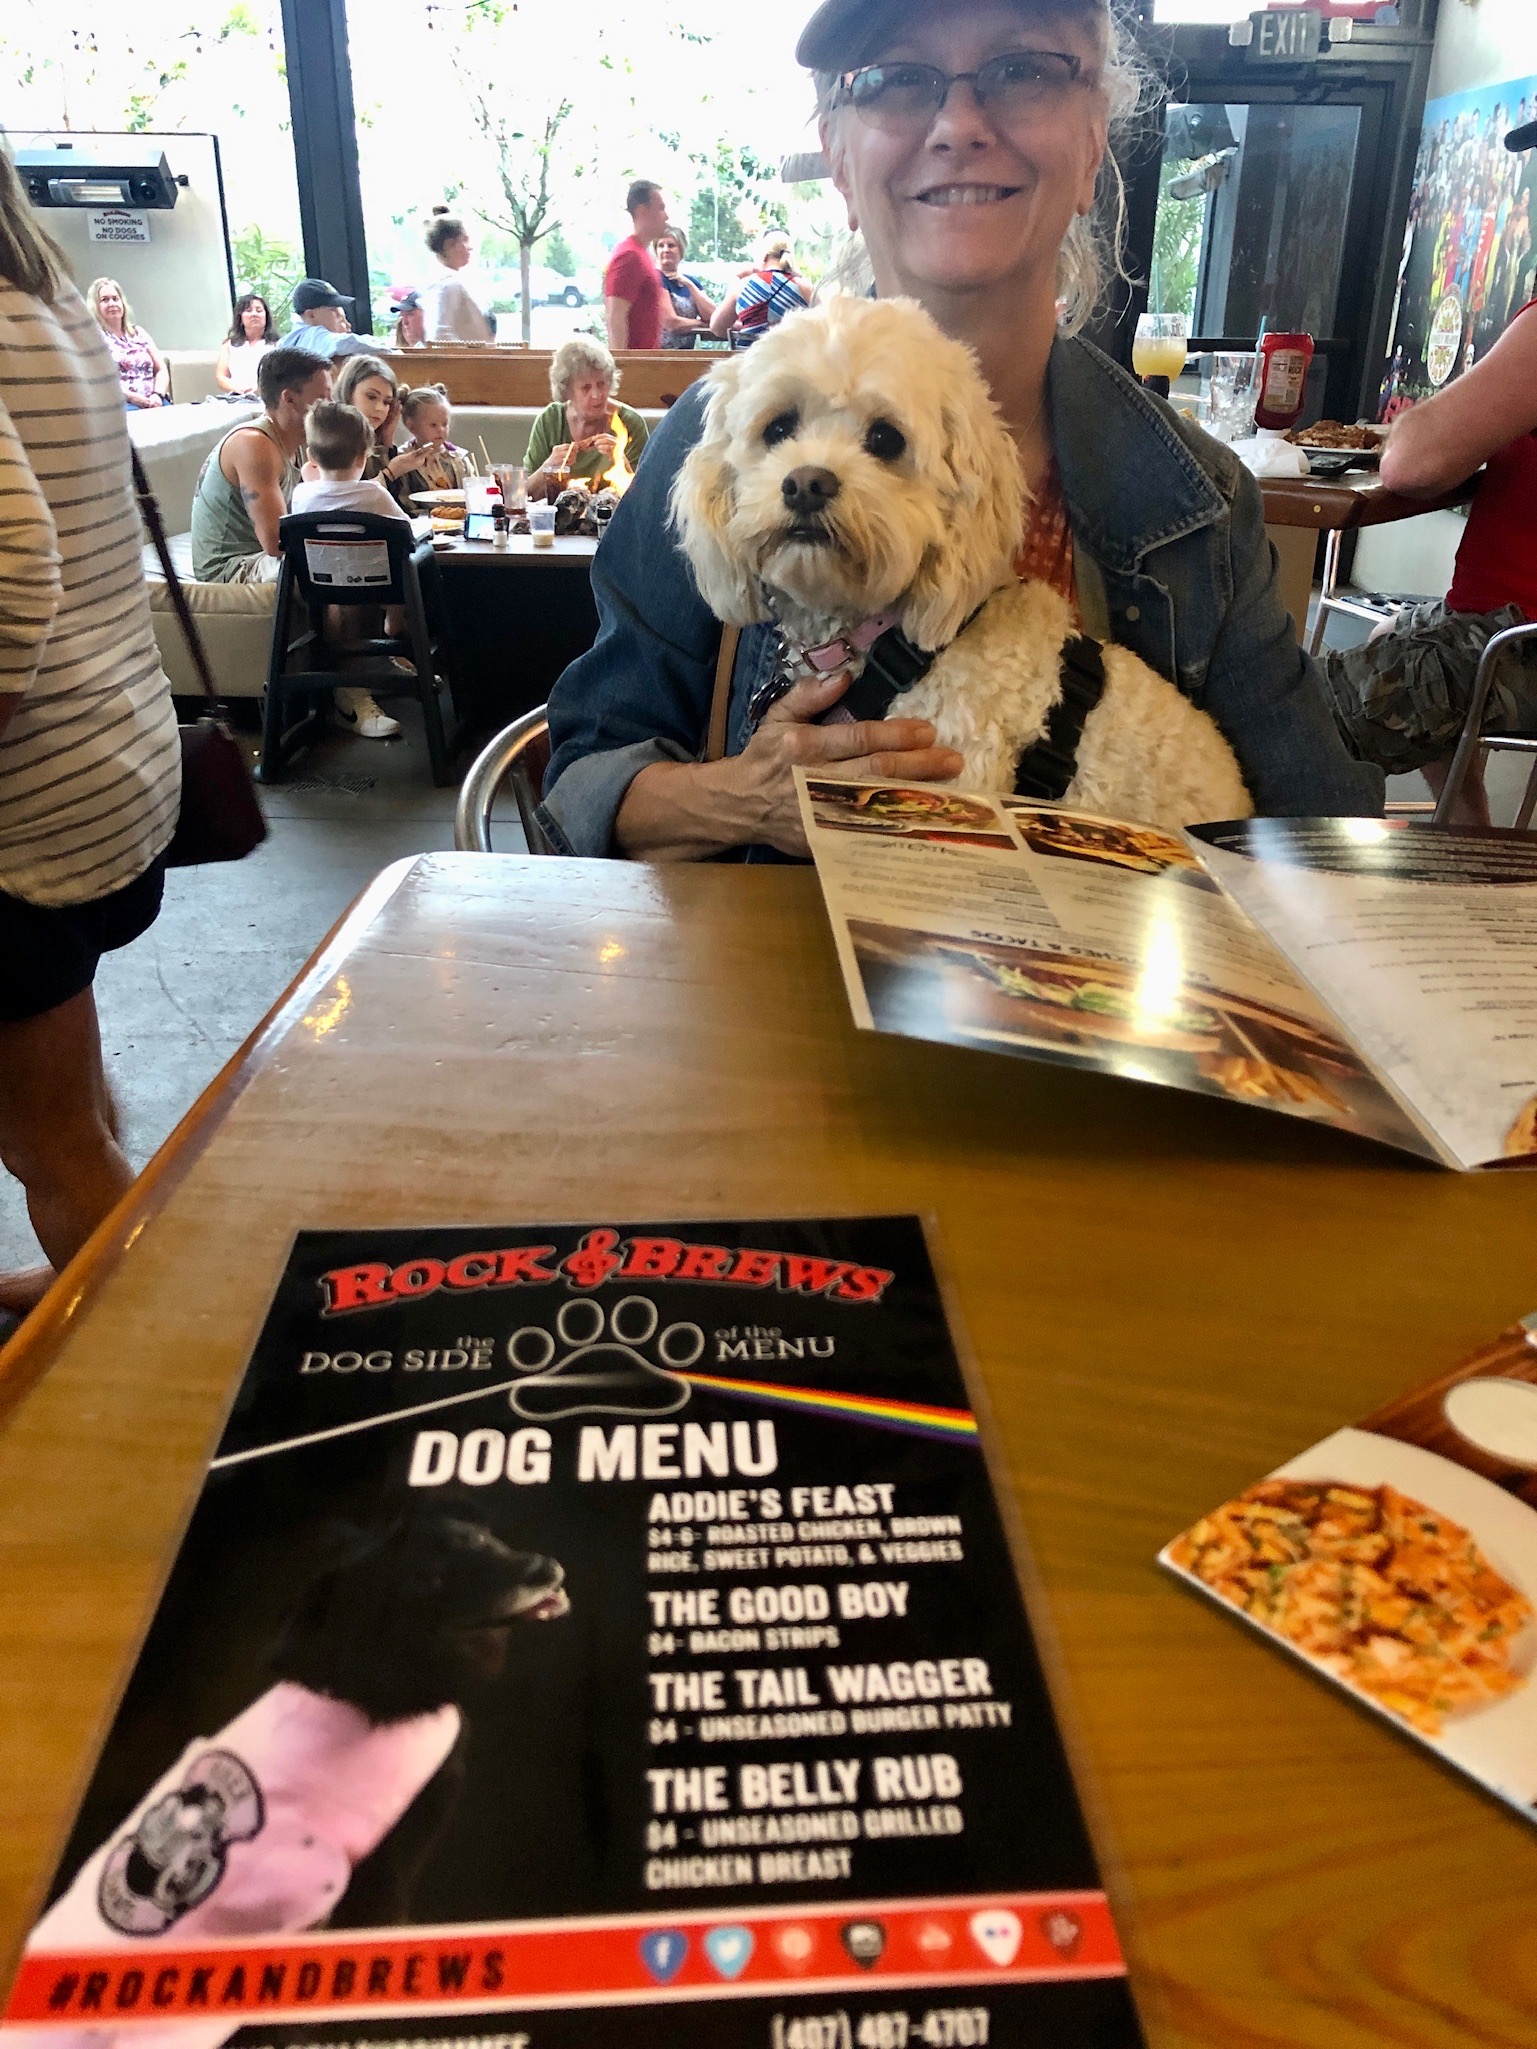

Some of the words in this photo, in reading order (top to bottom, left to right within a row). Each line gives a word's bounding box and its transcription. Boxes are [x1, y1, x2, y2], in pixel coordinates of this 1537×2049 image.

[1260, 12, 1308, 55] EXIT
[107, 218, 143, 226] SMOKING
[108, 233, 146, 241] COUCHES
[317, 1245, 557, 1319] ROCK
[612, 1235, 895, 1304] BREWS
[455, 1335, 495, 1349] the
[714, 1325, 739, 1340] of
[745, 1324, 783, 1340] the
[299, 1351, 394, 1374] DOG
[403, 1349, 493, 1372] SIDE
[715, 1336, 836, 1362] MENU
[408, 1426, 553, 1487] DOG
[577, 1419, 779, 1482] MENU
[648, 1487, 784, 1524] ADDIE'S
[790, 1483, 897, 1519] FEAST
[706, 1522, 795, 1546] ROASTED
[797, 1518, 889, 1542] CHICKEN,
[890, 1515, 963, 1538] BROWN
[647, 1550, 699, 1575] RICE,
[703, 1547, 770, 1572] SWEET
[774, 1543, 855, 1569] POTATO,
[858, 1543, 878, 1565] &
[879, 1539, 965, 1564] VEGGIES
[647, 1588, 721, 1628] THE
[728, 1584, 831, 1624] GOOD
[837, 1581, 909, 1620] BOY
[688, 1628, 761, 1654] BACON
[764, 1625, 841, 1651] STRIPS
[647, 1671, 726, 1712] THE
[733, 1667, 821, 1709] TAIL
[825, 1657, 993, 1703] WAGGER
[699, 1709, 848, 1742] UNSEASONED
[851, 1704, 941, 1735] BURGER
[942, 1701, 1012, 1728] PATTY
[647, 1765, 731, 1814] THE
[738, 1757, 862, 1810] BELLY
[872, 1753, 963, 1802] RUB
[701, 1810, 860, 1848] UNSEASONED
[863, 1804, 965, 1839] GRILLED
[645, 1853, 753, 1890] CHICKEN
[758, 1848, 853, 1884] BREAST
